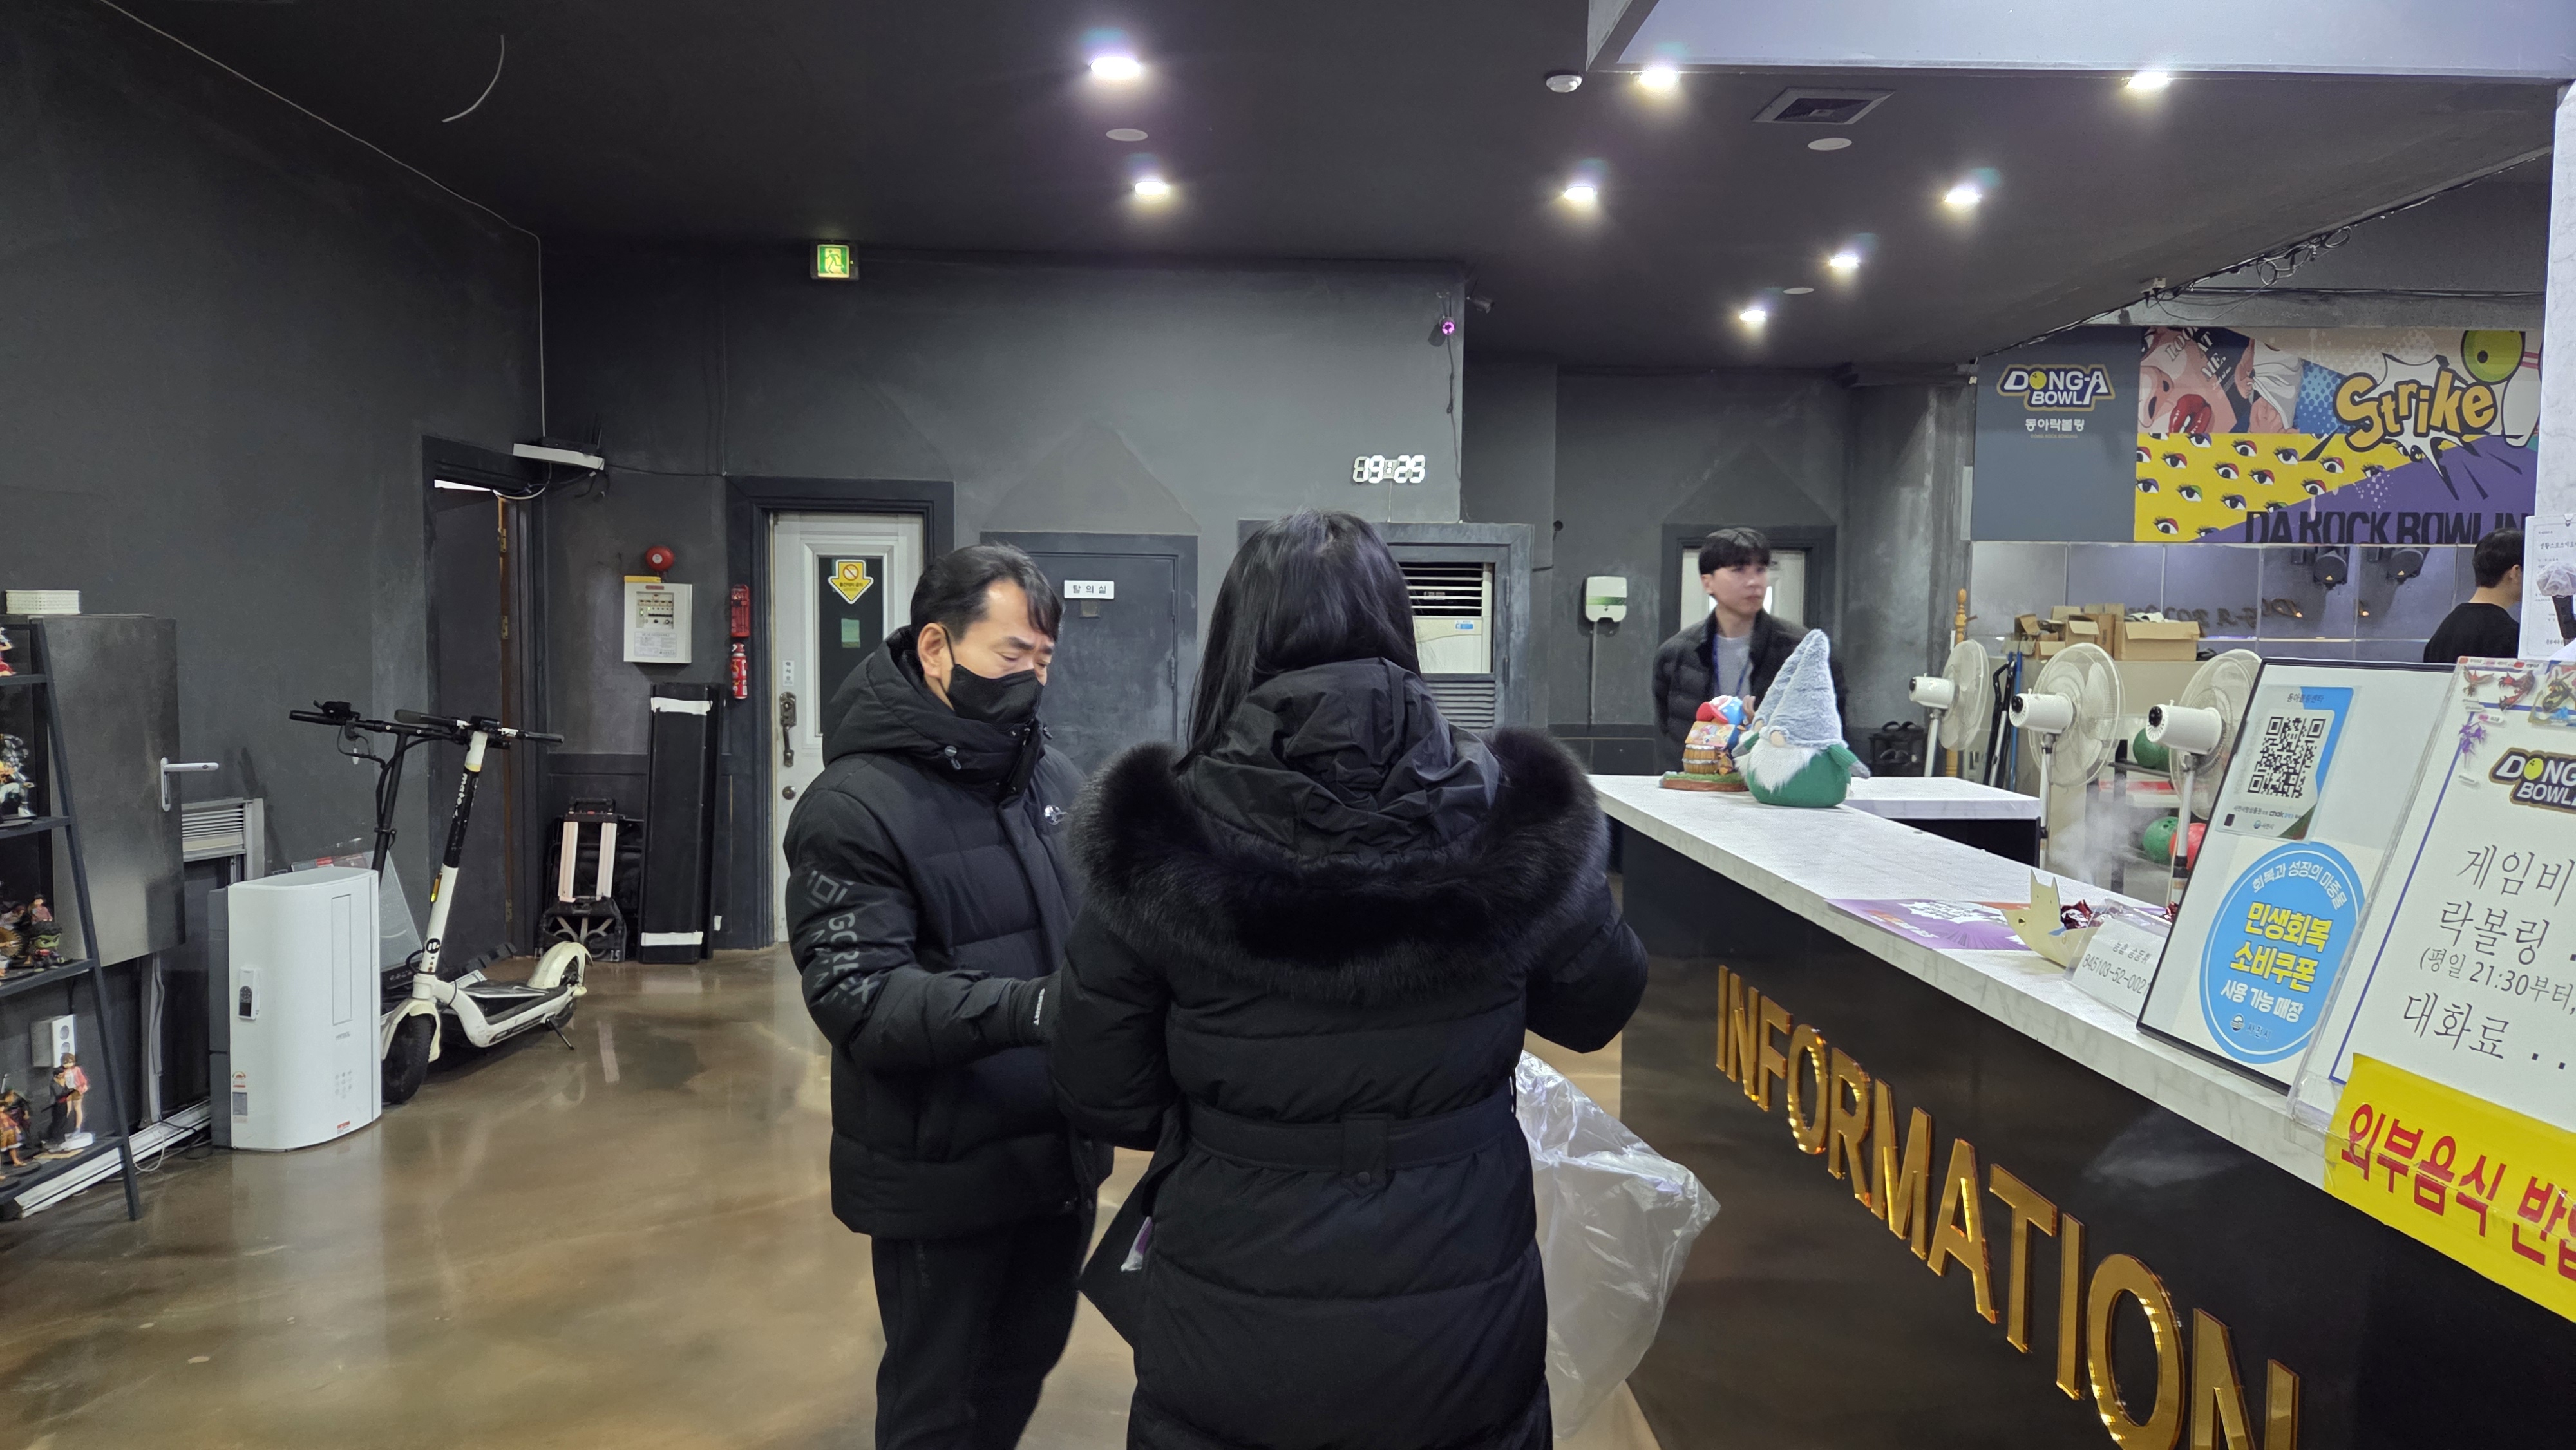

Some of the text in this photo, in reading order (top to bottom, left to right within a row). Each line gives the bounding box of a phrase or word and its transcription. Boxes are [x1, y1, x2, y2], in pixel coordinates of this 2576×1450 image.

[2031, 391, 2083, 405] BOWL
[2335, 369, 2496, 449] Strike
[2025, 419, 2085, 432] 동아락볼링
[1363, 454, 1426, 484] 19:25
[2245, 511, 2292, 544] DA
[2299, 511, 2392, 544] ROCK
[2252, 863, 2286, 893] 회복과
[2288, 860, 2323, 881] 성장의
[2456, 845, 2575, 907] 게임비
[2244, 901, 2333, 952] 민생회복
[2439, 900, 2550, 965] 락볼링
[2230, 941, 2319, 993] 소비쿠폰
[2420, 947, 2467, 979] (평일
[2221, 979, 2304, 1023] 사용 가능 매장
[2403, 992, 2510, 1059] 대화료
[1715, 966, 2300, 1450] INFORMATION
[2341, 1104, 2576, 1283] 외부음식 반
